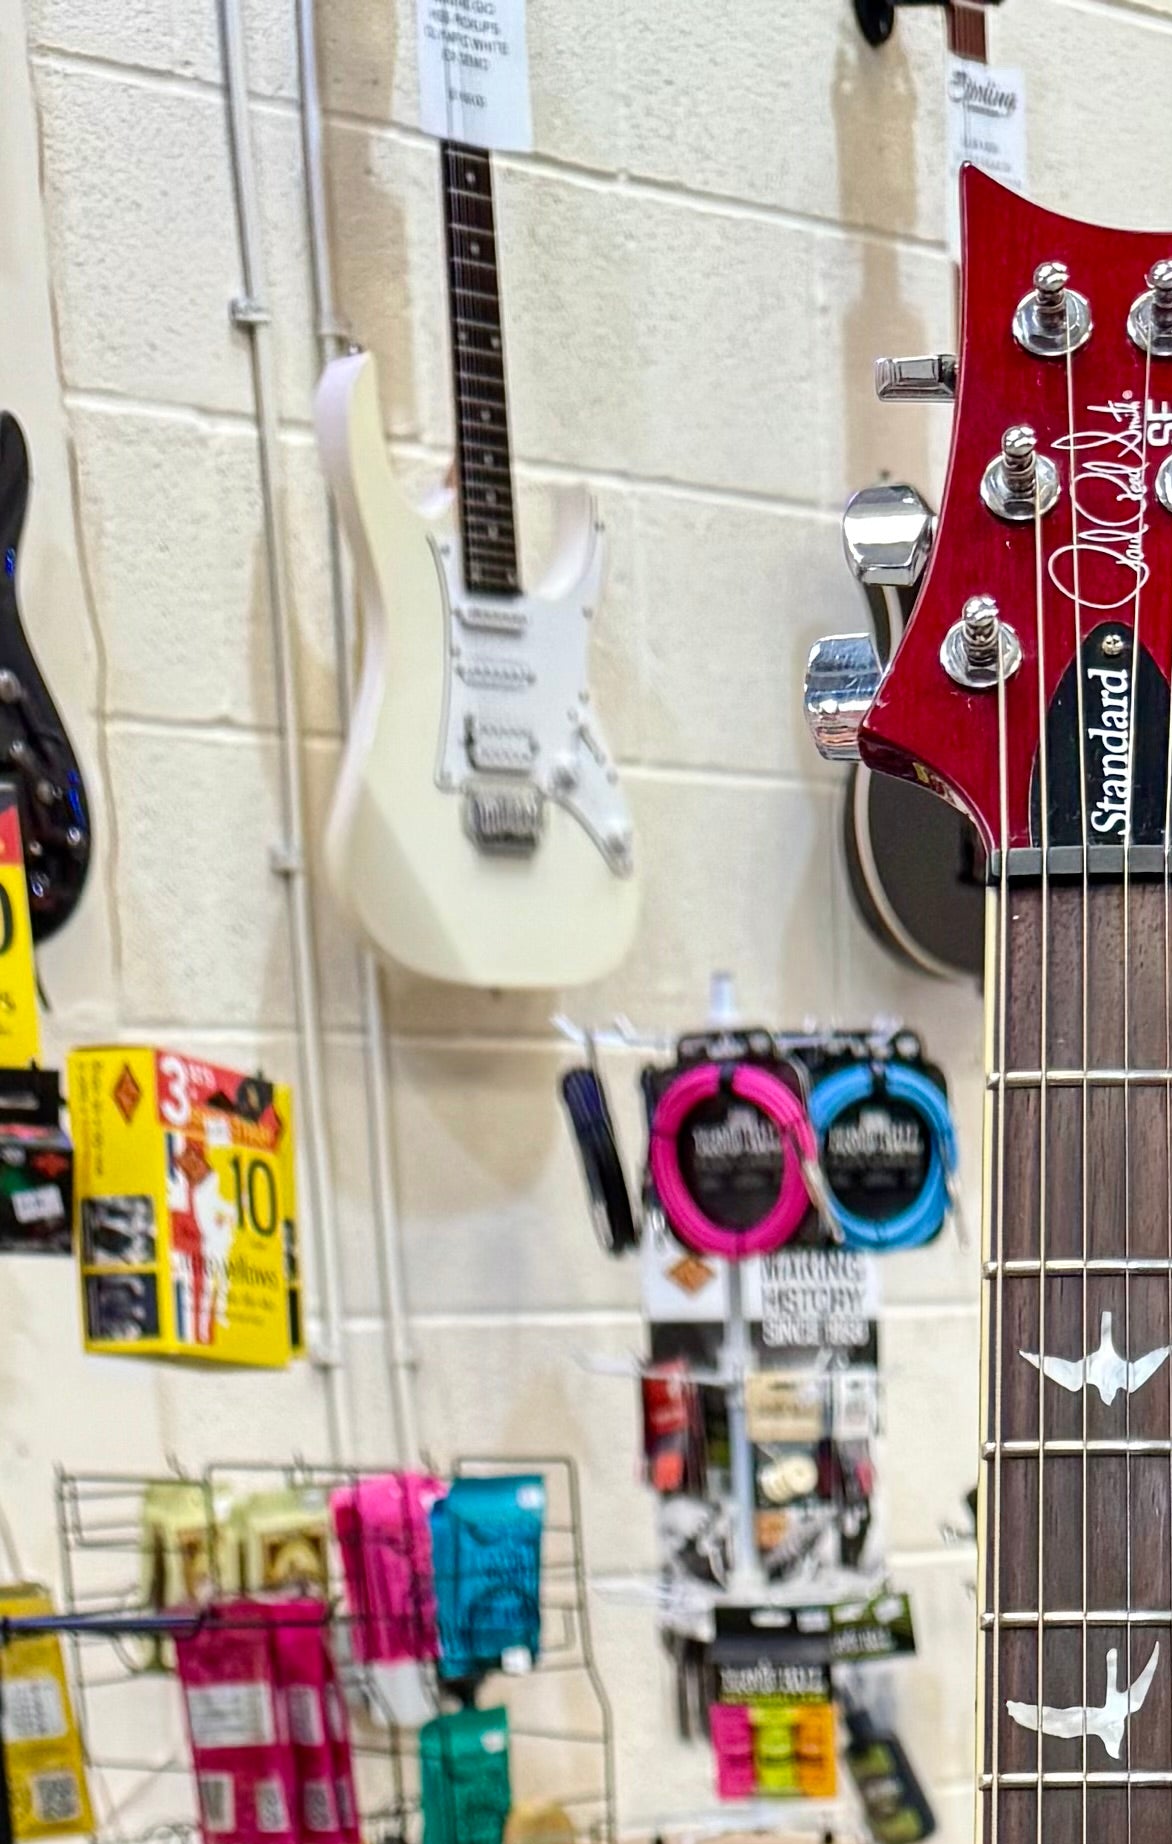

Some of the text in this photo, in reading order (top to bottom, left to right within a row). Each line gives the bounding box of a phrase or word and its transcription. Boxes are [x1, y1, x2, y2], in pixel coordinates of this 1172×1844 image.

[1087, 668, 1130, 837] Standard
[160, 1053, 189, 1126] 3
[231, 1154, 278, 1238] 10
